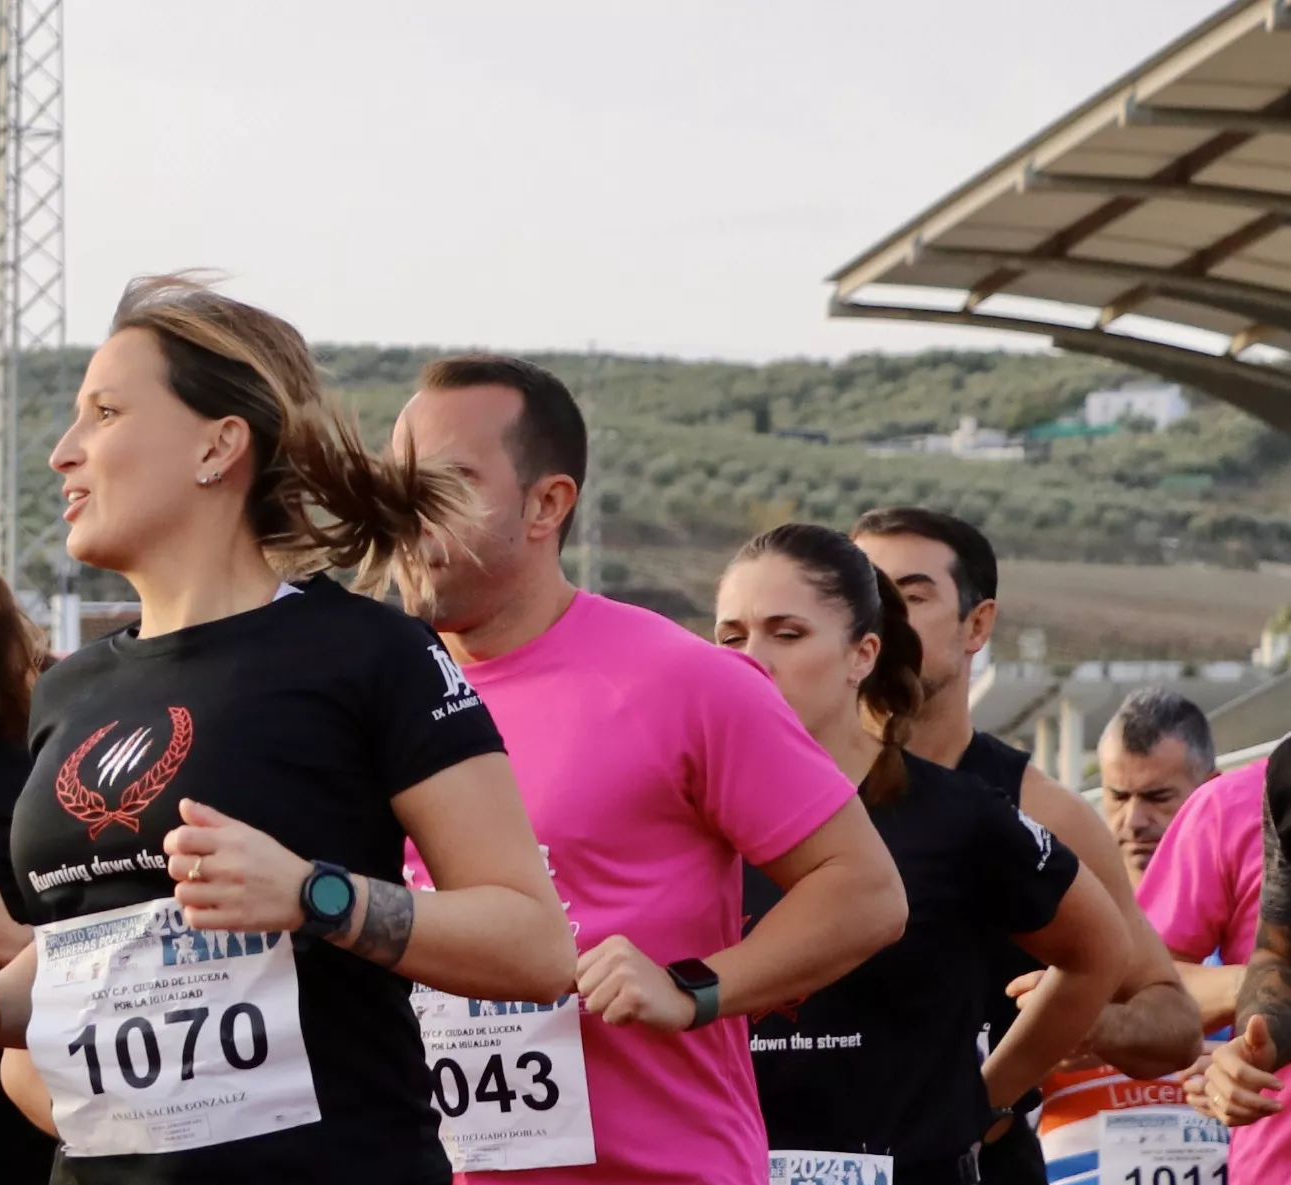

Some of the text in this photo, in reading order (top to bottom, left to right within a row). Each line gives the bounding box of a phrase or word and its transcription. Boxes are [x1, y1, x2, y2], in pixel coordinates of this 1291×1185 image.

[431, 707, 447, 721] IX
[28, 849, 167, 893] Running down the
[45, 929, 86, 950] CIRCUITO
[86, 917, 140, 941] PROVINCIAL
[47, 939, 98, 960] CARRERAS
[132, 979, 170, 993] CIUDAD
[171, 976, 186, 987] DE
[187, 971, 230, 985] LUCENA
[114, 988, 204, 1011] POR LA IGUALDAD
[445, 1028, 475, 1038] CIUDAD
[475, 1027, 488, 1036] DE
[489, 1025, 523, 1035] LUCENA
[749, 1032, 863, 1052] down the street
[68, 1002, 269, 1095] 1070
[431, 1039, 502, 1051] POR LA IGUALDAD
[146, 1103, 183, 1118] SACHA
[184, 1091, 249, 1112] GONZÁLEZ
[462, 1131, 508, 1142] DELGADO
[508, 1129, 549, 1140] DOBLAS
[790, 1156, 846, 1179] 2024
